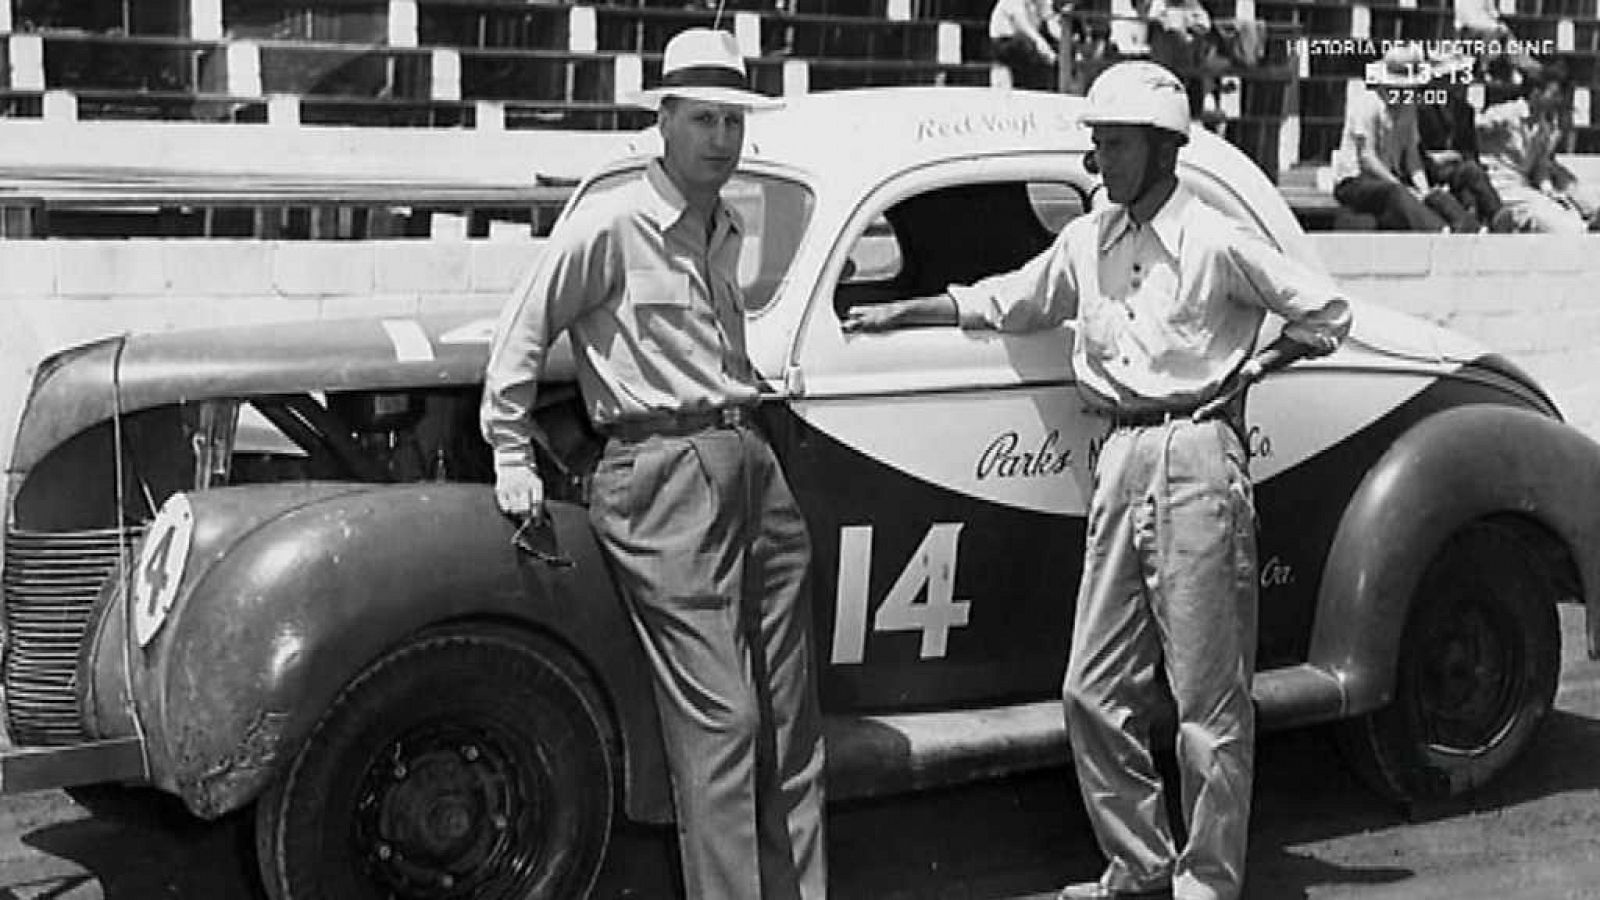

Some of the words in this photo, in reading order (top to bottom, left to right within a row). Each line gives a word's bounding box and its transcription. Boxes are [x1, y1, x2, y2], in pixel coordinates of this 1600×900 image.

[916, 114, 972, 142] Red
[976, 430, 1072, 480] Parks
[145, 526, 176, 617] 4
[830, 522, 971, 665] 14
